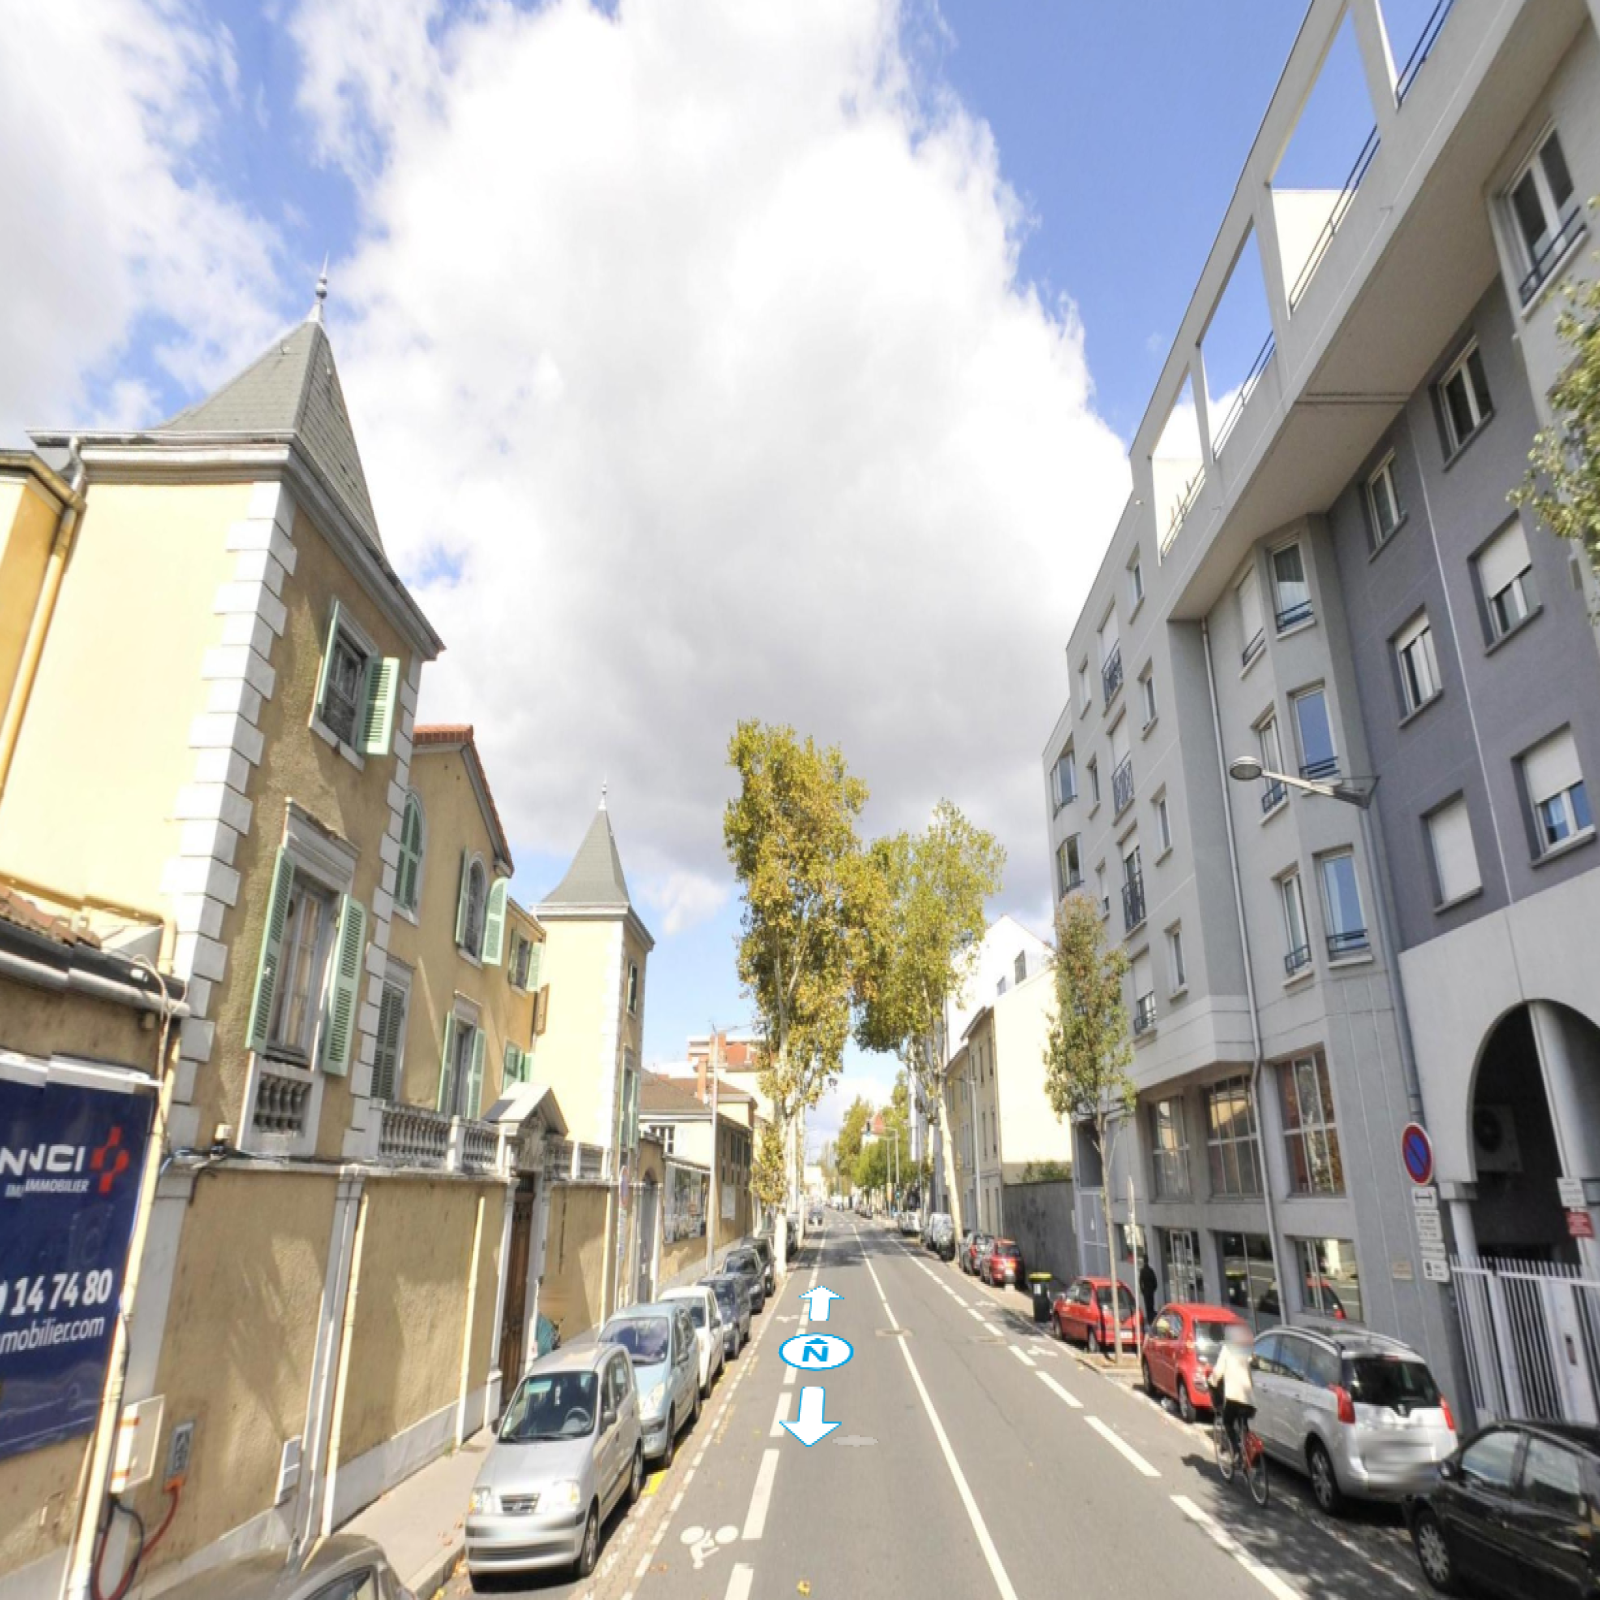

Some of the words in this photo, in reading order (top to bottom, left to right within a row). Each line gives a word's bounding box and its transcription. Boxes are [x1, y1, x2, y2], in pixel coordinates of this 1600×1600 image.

[10, 1276, 45, 1316] 14
[48, 1271, 80, 1311] 74
[82, 1267, 113, 1306] 80
